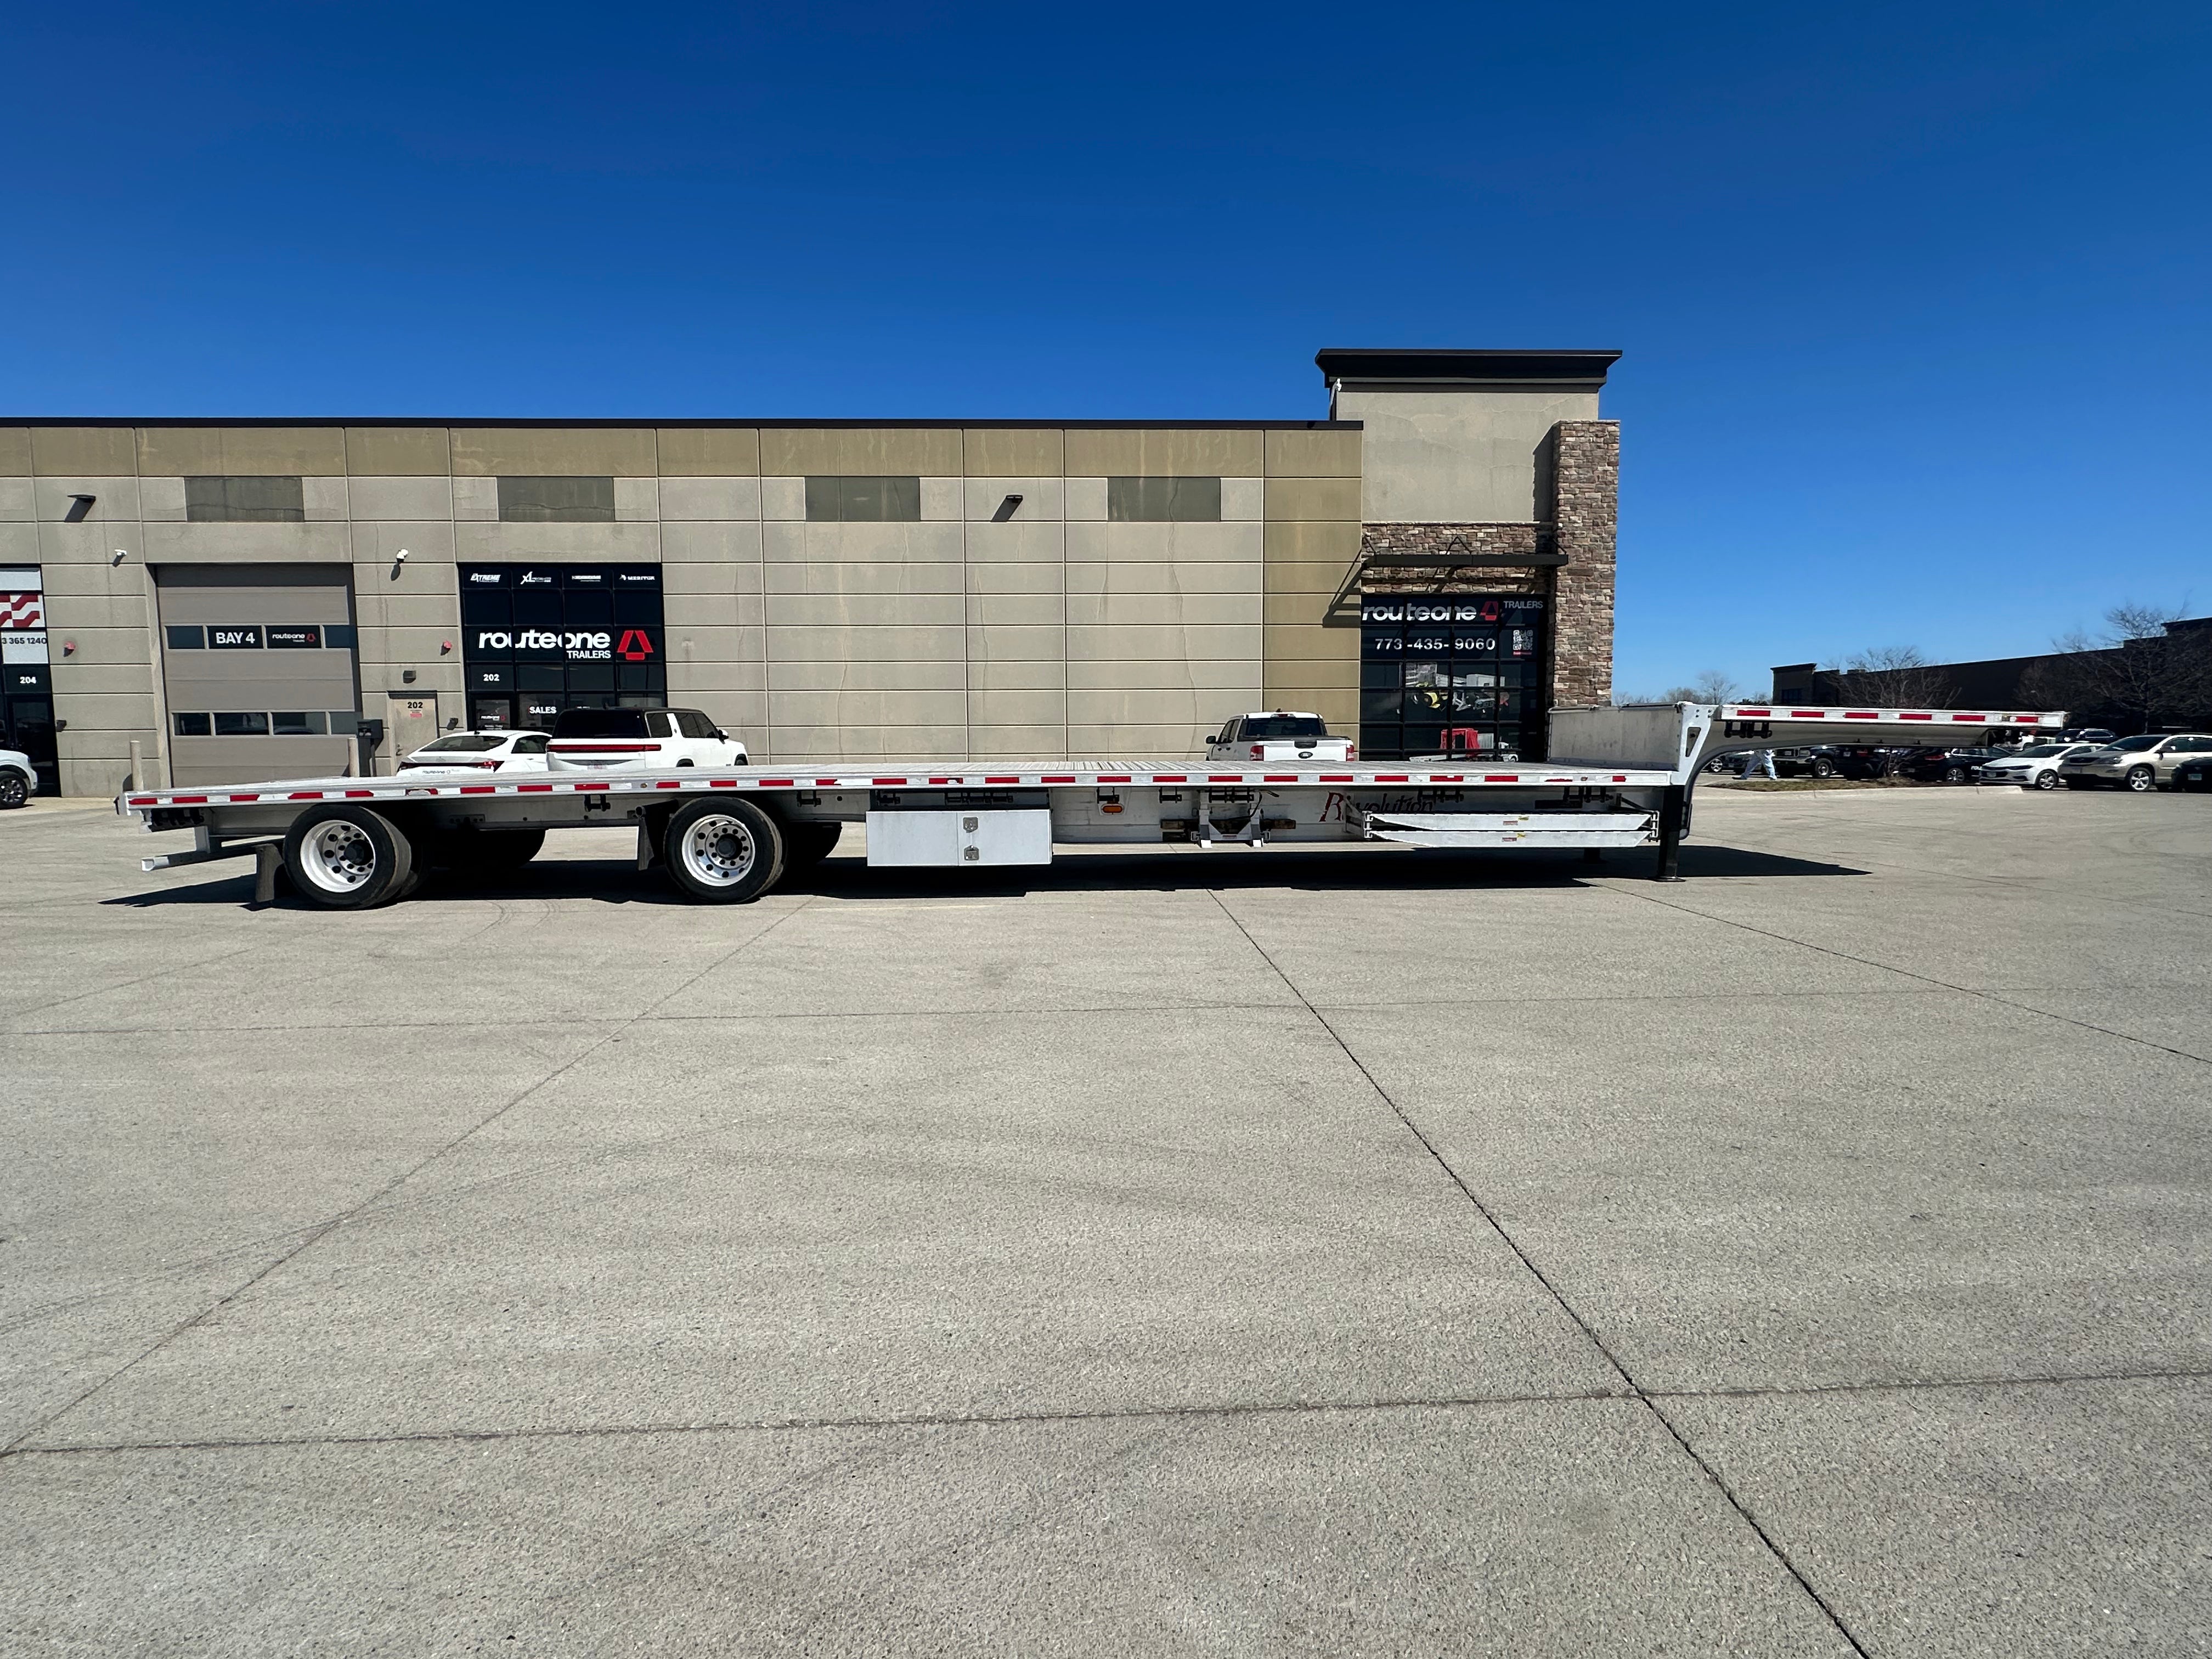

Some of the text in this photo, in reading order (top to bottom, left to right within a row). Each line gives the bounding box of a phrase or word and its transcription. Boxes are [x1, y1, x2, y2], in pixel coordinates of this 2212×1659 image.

[1503, 601, 1543, 609] TRAILERS
[1362, 603, 1477, 621] routeone
[216, 632, 256, 644] BAY 4
[478, 629, 611, 648] routeone
[566, 650, 611, 659] TRAILERS
